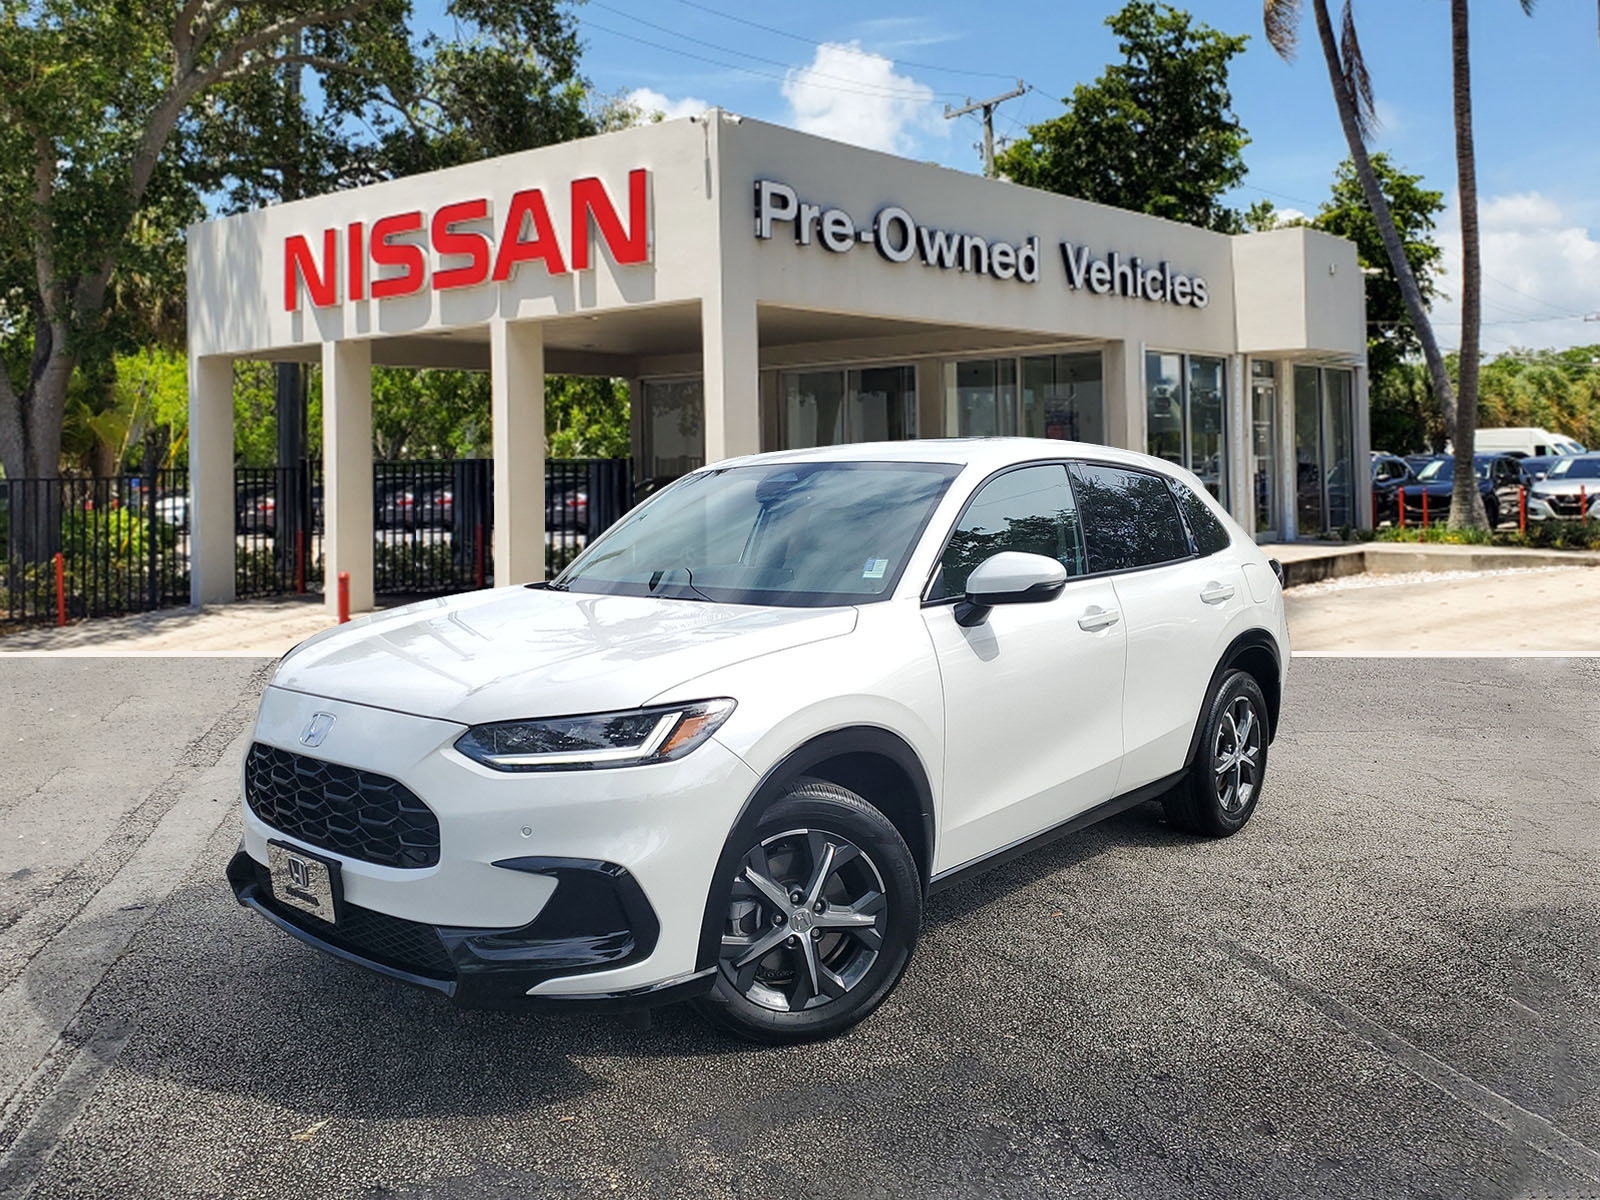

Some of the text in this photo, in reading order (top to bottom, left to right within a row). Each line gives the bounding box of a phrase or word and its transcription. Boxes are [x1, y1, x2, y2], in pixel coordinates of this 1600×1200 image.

[284, 168, 648, 312] NISSAN
[755, 180, 1209, 308] Pre-Owned Vehicles
